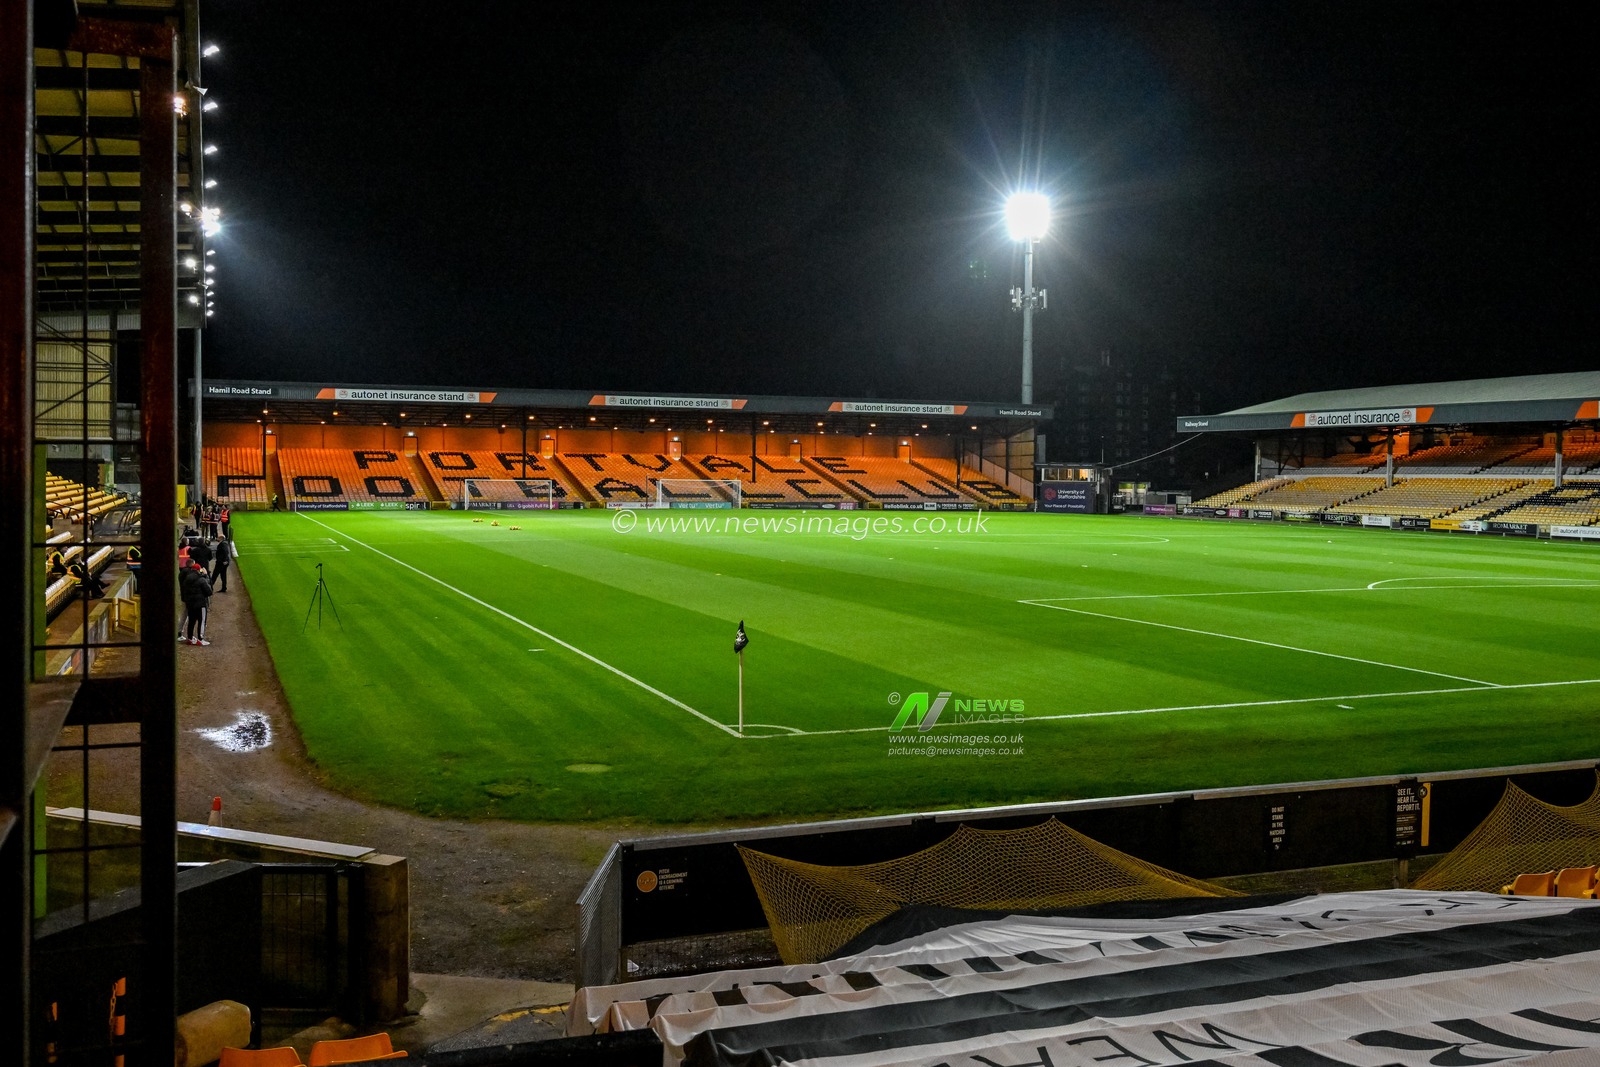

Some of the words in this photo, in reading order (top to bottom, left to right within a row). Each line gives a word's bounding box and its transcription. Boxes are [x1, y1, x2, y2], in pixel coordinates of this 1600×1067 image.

[209, 386, 230, 395] Hamil
[231, 387, 250, 396] Road
[251, 388, 272, 396] Stand
[351, 390, 388, 400] autonet
[390, 391, 436, 401] insurance
[438, 392, 464, 401] stand
[619, 397, 651, 406] autonet
[653, 397, 694, 407] insurance
[695, 399, 718, 408] stand
[855, 404, 884, 412] autonet
[885, 404, 921, 413] insurance
[922, 405, 943, 413] stand
[1317, 413, 1352, 425] autonet
[1354, 410, 1401, 424] insurance
[353, 450, 607, 472] PORT
[621, 453, 867, 474] VALE
[216, 474, 786, 499] FOOTBALL
[785, 479, 1022, 499] CLUB
[405, 502, 427, 510] spirl
[1397, 796, 1409, 804] HEAR
[1397, 804, 1414, 812] REPORT
